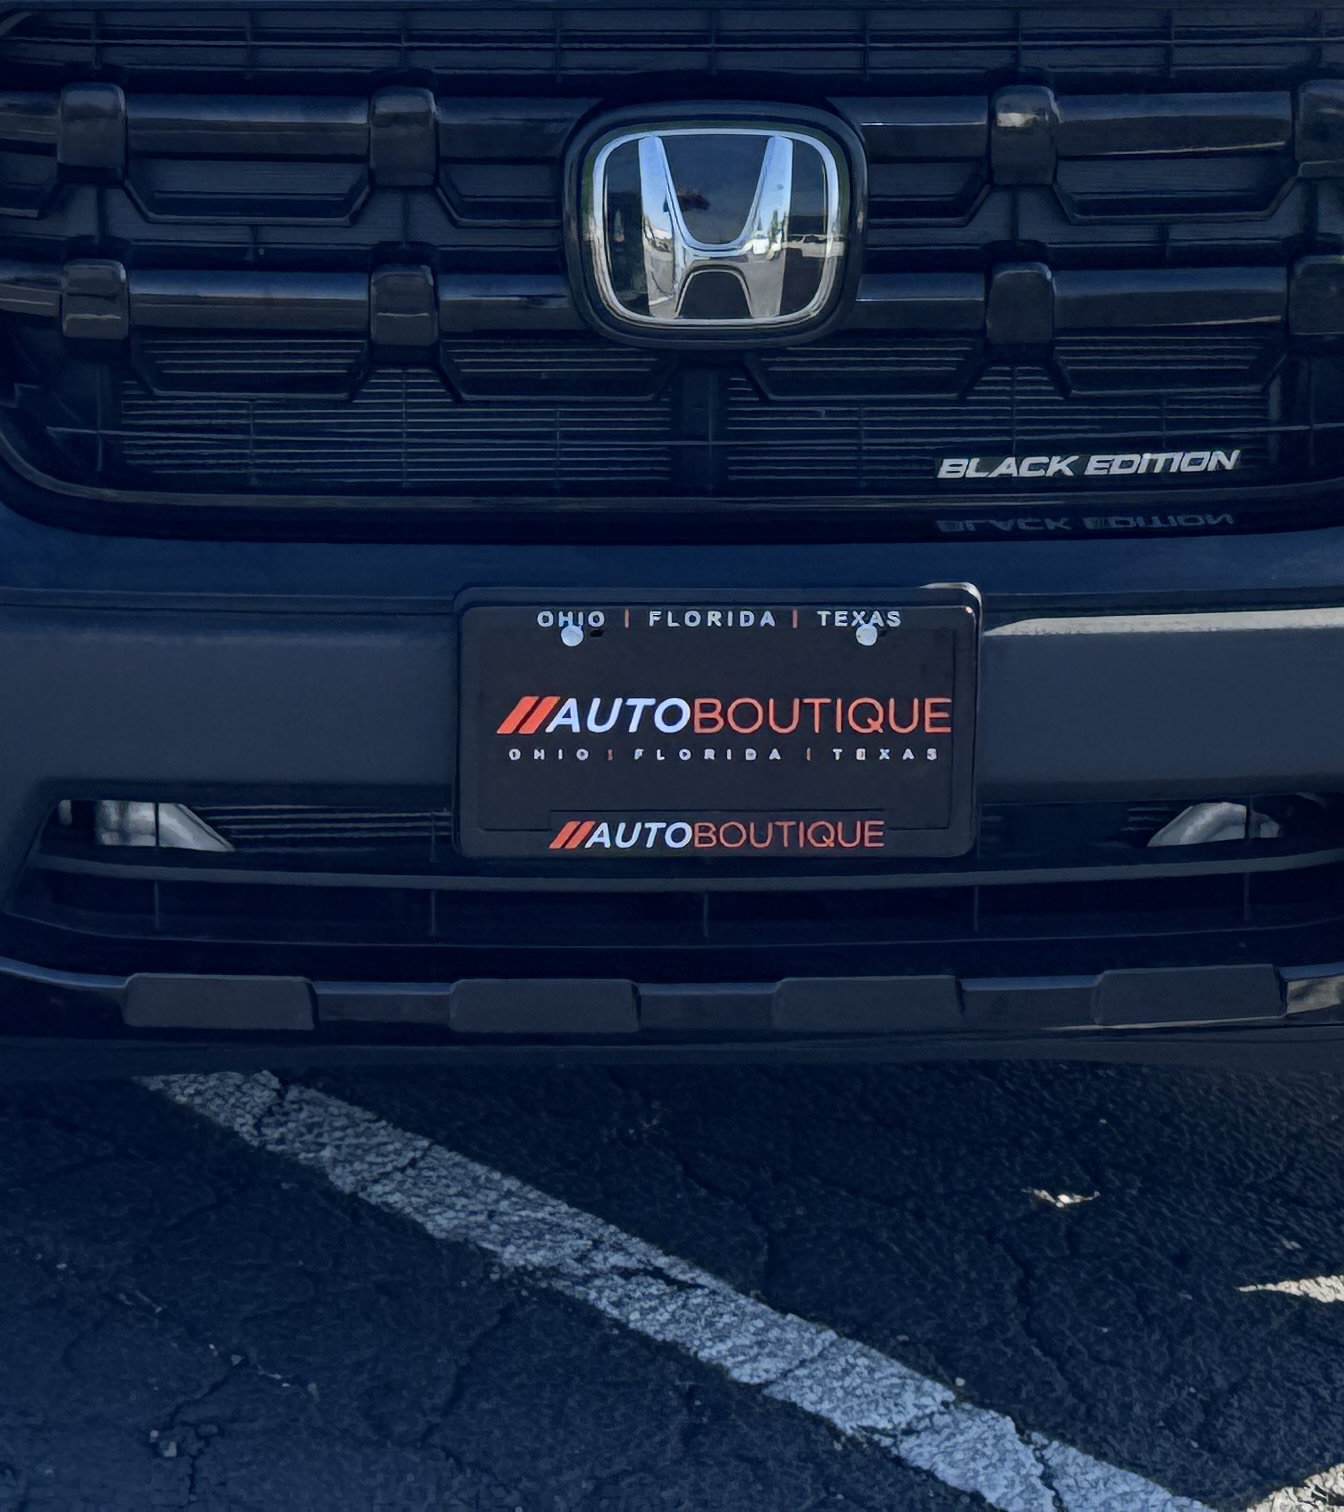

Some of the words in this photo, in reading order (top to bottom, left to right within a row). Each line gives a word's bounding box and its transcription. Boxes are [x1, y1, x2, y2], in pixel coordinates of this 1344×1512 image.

[937, 455, 1080, 479] BLACK
[1084, 449, 1241, 476] EDITION
[537, 610, 605, 628] OHIO
[648, 610, 776, 628] FLORIDA
[816, 610, 902, 628] TEXAS
[544, 696, 952, 735] AUTOBOUTIQUE
[508, 747, 589, 761] OHIO
[633, 747, 782, 761] FLORIDA
[832, 747, 938, 761] TEXAS
[584, 820, 885, 849] AUTOBOUTIQUE
